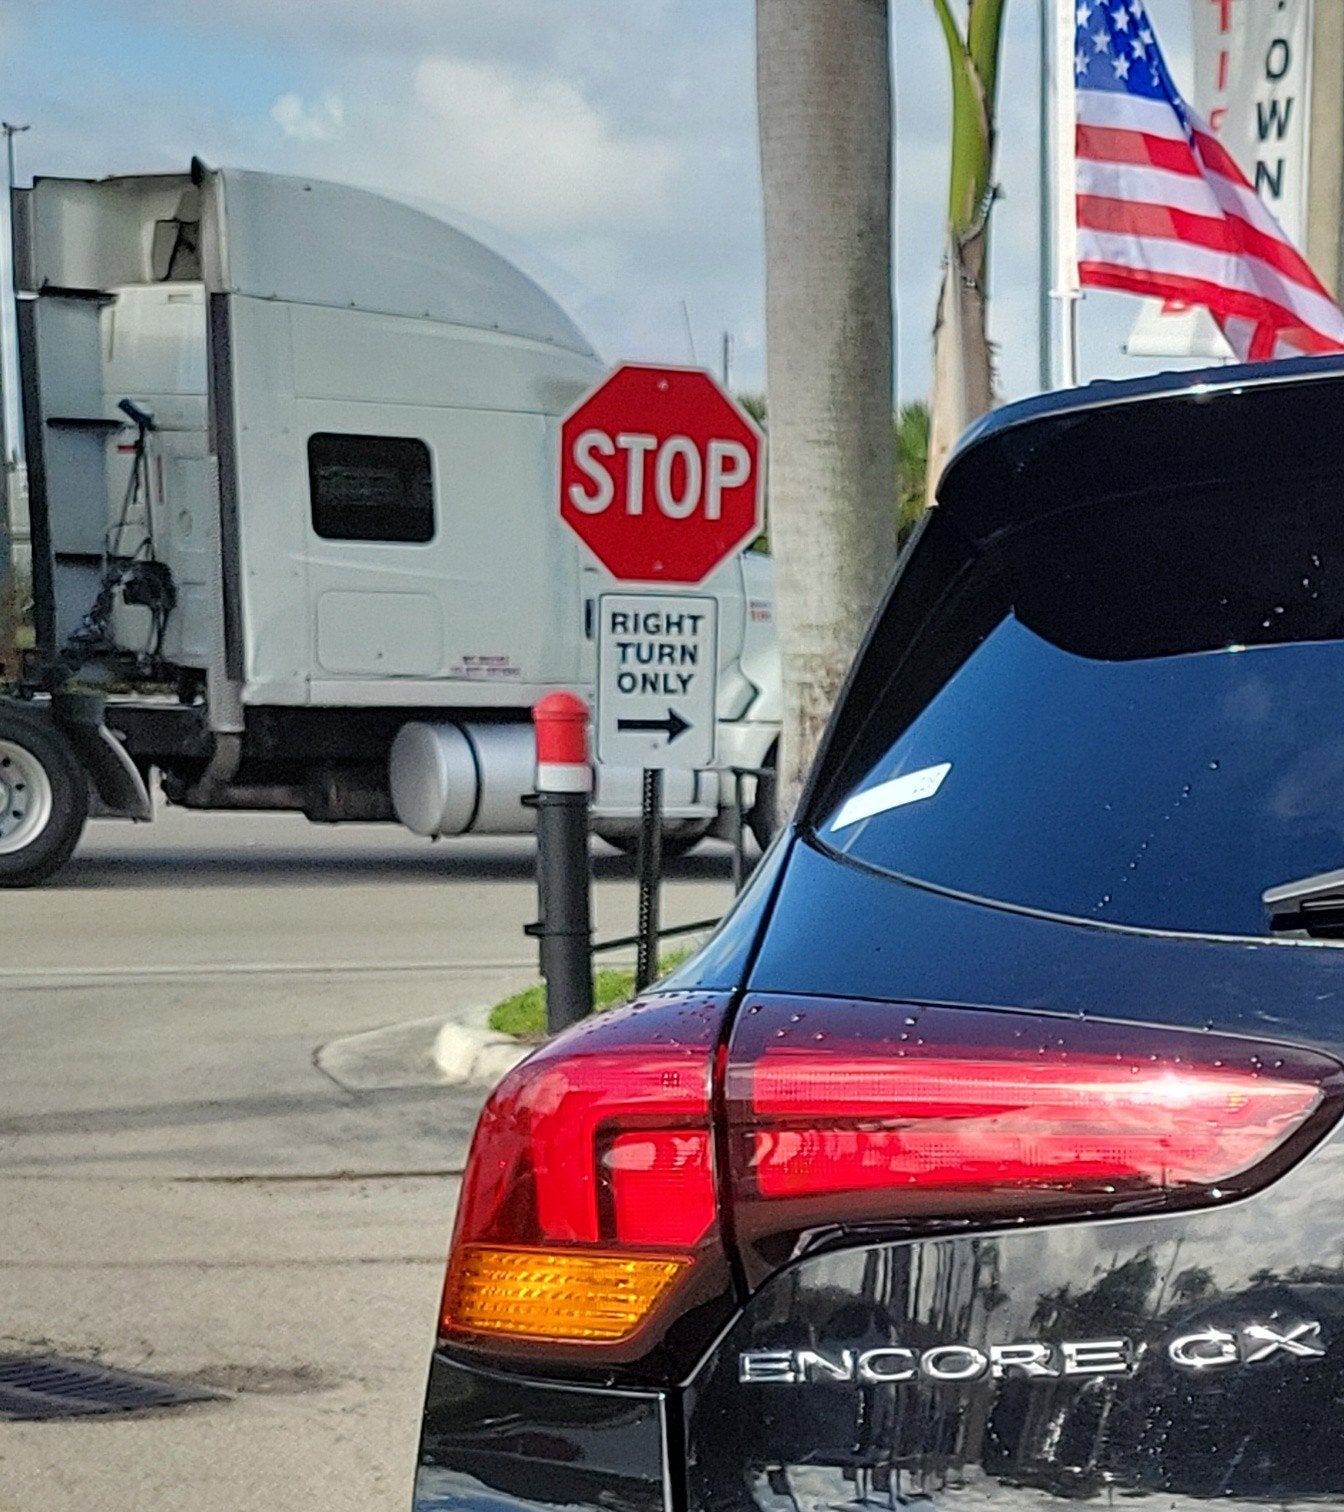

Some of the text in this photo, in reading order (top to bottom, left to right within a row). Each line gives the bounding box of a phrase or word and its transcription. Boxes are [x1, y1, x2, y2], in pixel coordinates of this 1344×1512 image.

[568, 428, 751, 520] STOP
[611, 612, 704, 635] RIGHT
[617, 642, 698, 665] TURN
[617, 673, 694, 695] ONLY
[740, 1320, 1327, 1384] ENCORE GX
